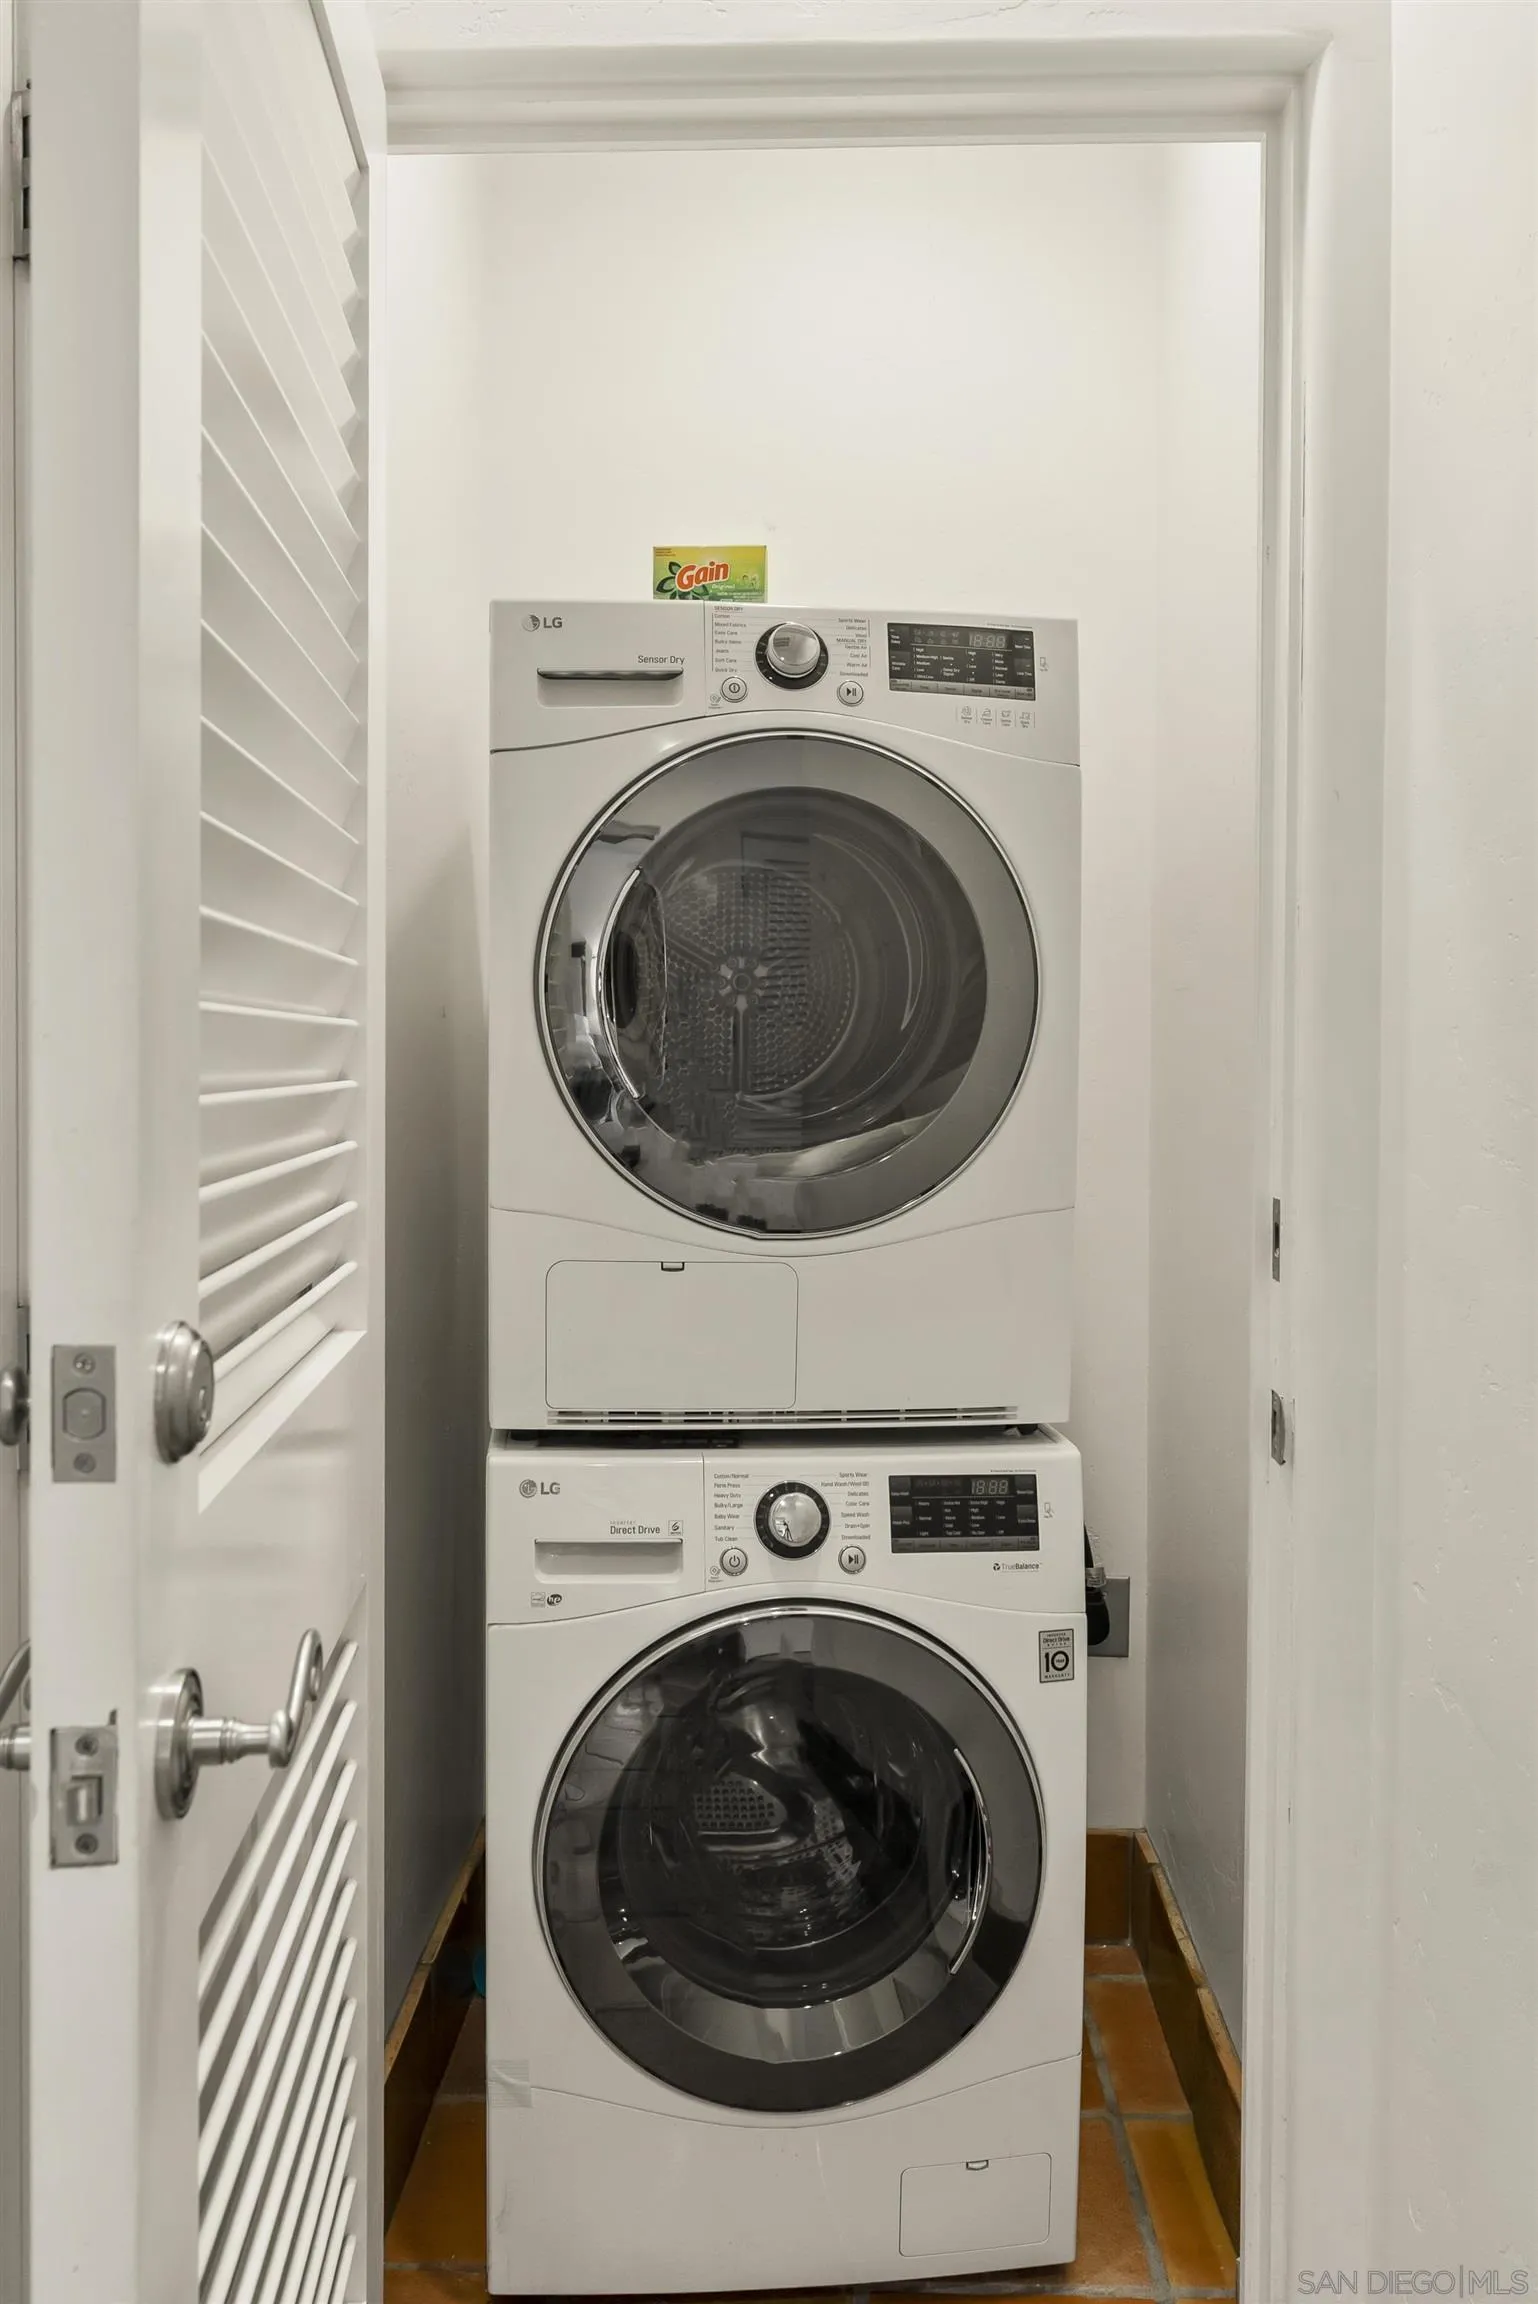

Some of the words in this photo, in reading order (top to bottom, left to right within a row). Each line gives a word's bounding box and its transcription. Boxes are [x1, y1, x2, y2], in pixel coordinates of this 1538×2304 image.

[676, 561, 729, 592] Gain
[543, 617, 563, 629] LG
[638, 655, 668, 665] Sensor
[670, 656, 685, 665] Dry
[540, 1482, 560, 1495] LG
[610, 1526, 636, 1535] Direct
[638, 1525, 660, 1534] Drive
[1045, 1651, 1069, 1673] 10
